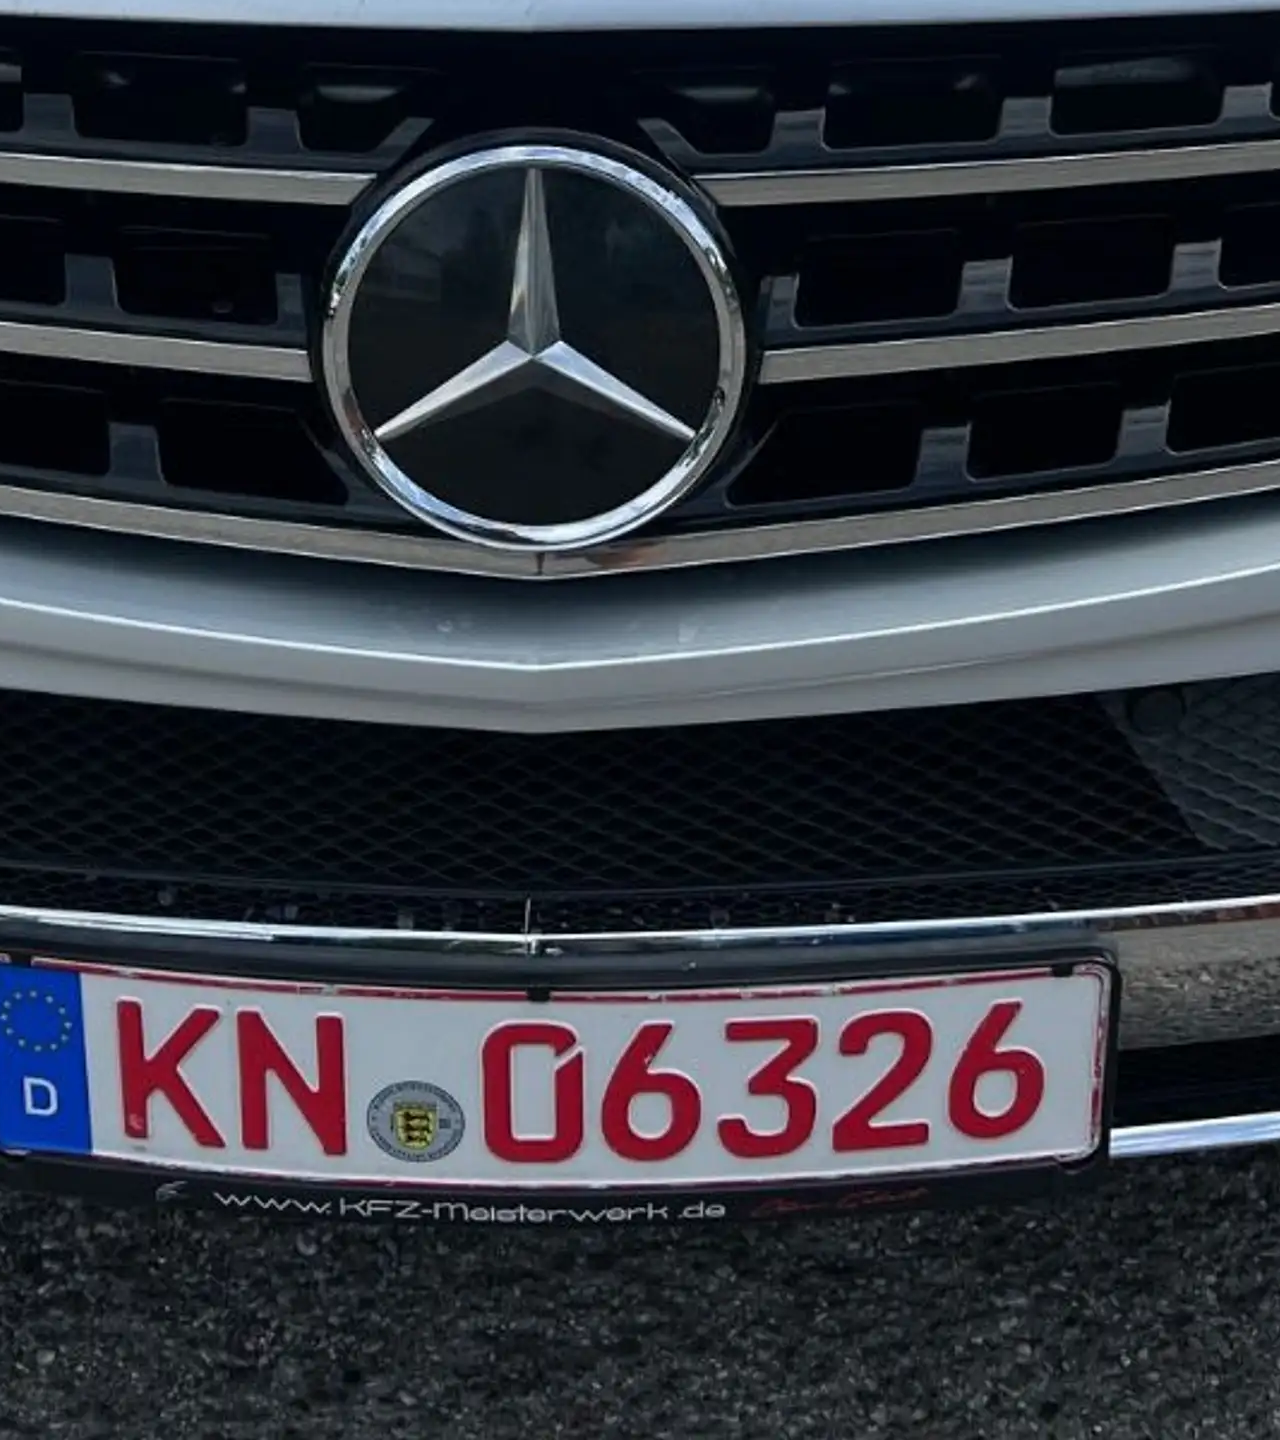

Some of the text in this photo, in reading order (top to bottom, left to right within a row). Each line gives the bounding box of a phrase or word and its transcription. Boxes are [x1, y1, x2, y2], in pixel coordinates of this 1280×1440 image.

[24, 1078, 58, 1116] D
[116, 998, 348, 1157] KN
[480, 999, 1047, 1165] 06326
